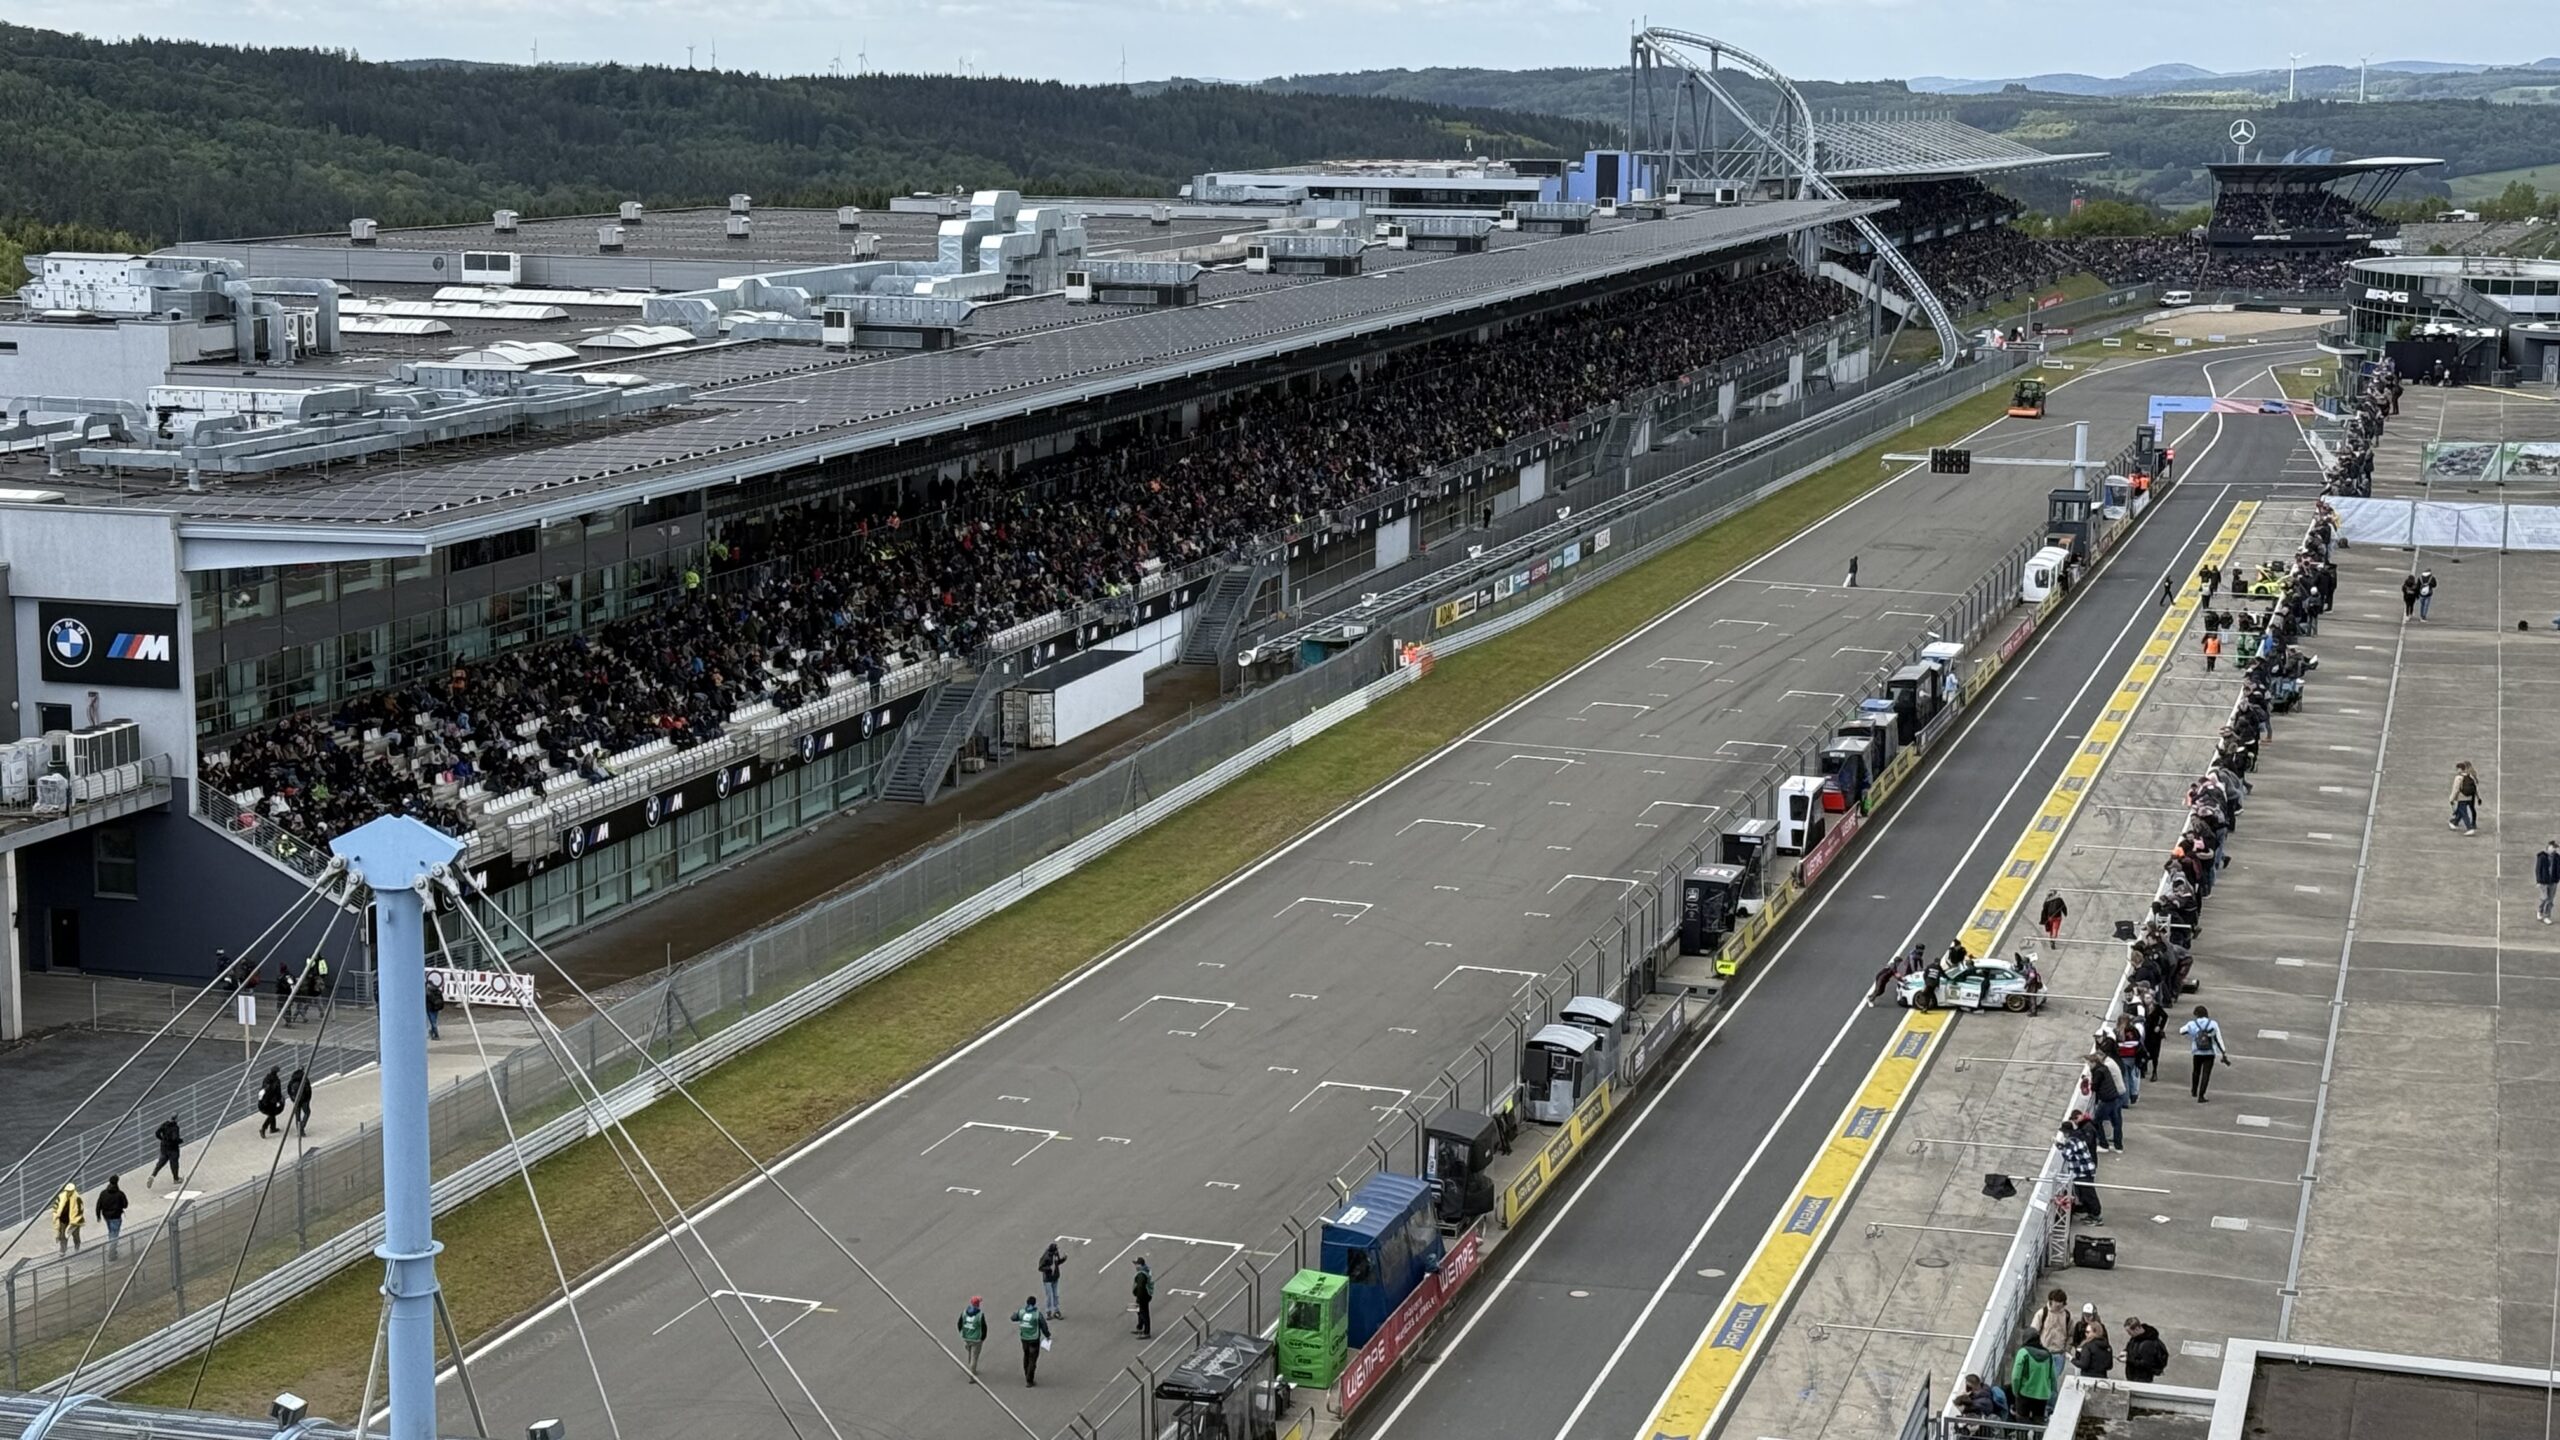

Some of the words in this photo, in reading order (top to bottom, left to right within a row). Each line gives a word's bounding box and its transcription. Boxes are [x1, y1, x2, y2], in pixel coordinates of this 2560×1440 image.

[2375, 289, 2409, 303] AMG
[133, 634, 170, 662] M
[1791, 1199, 1823, 1231] RAVENOL
[1438, 1242, 1475, 1292] WEMPE
[1722, 1307, 1758, 1346] RAVENOL
[1346, 1339, 1386, 1399] WEMPE
